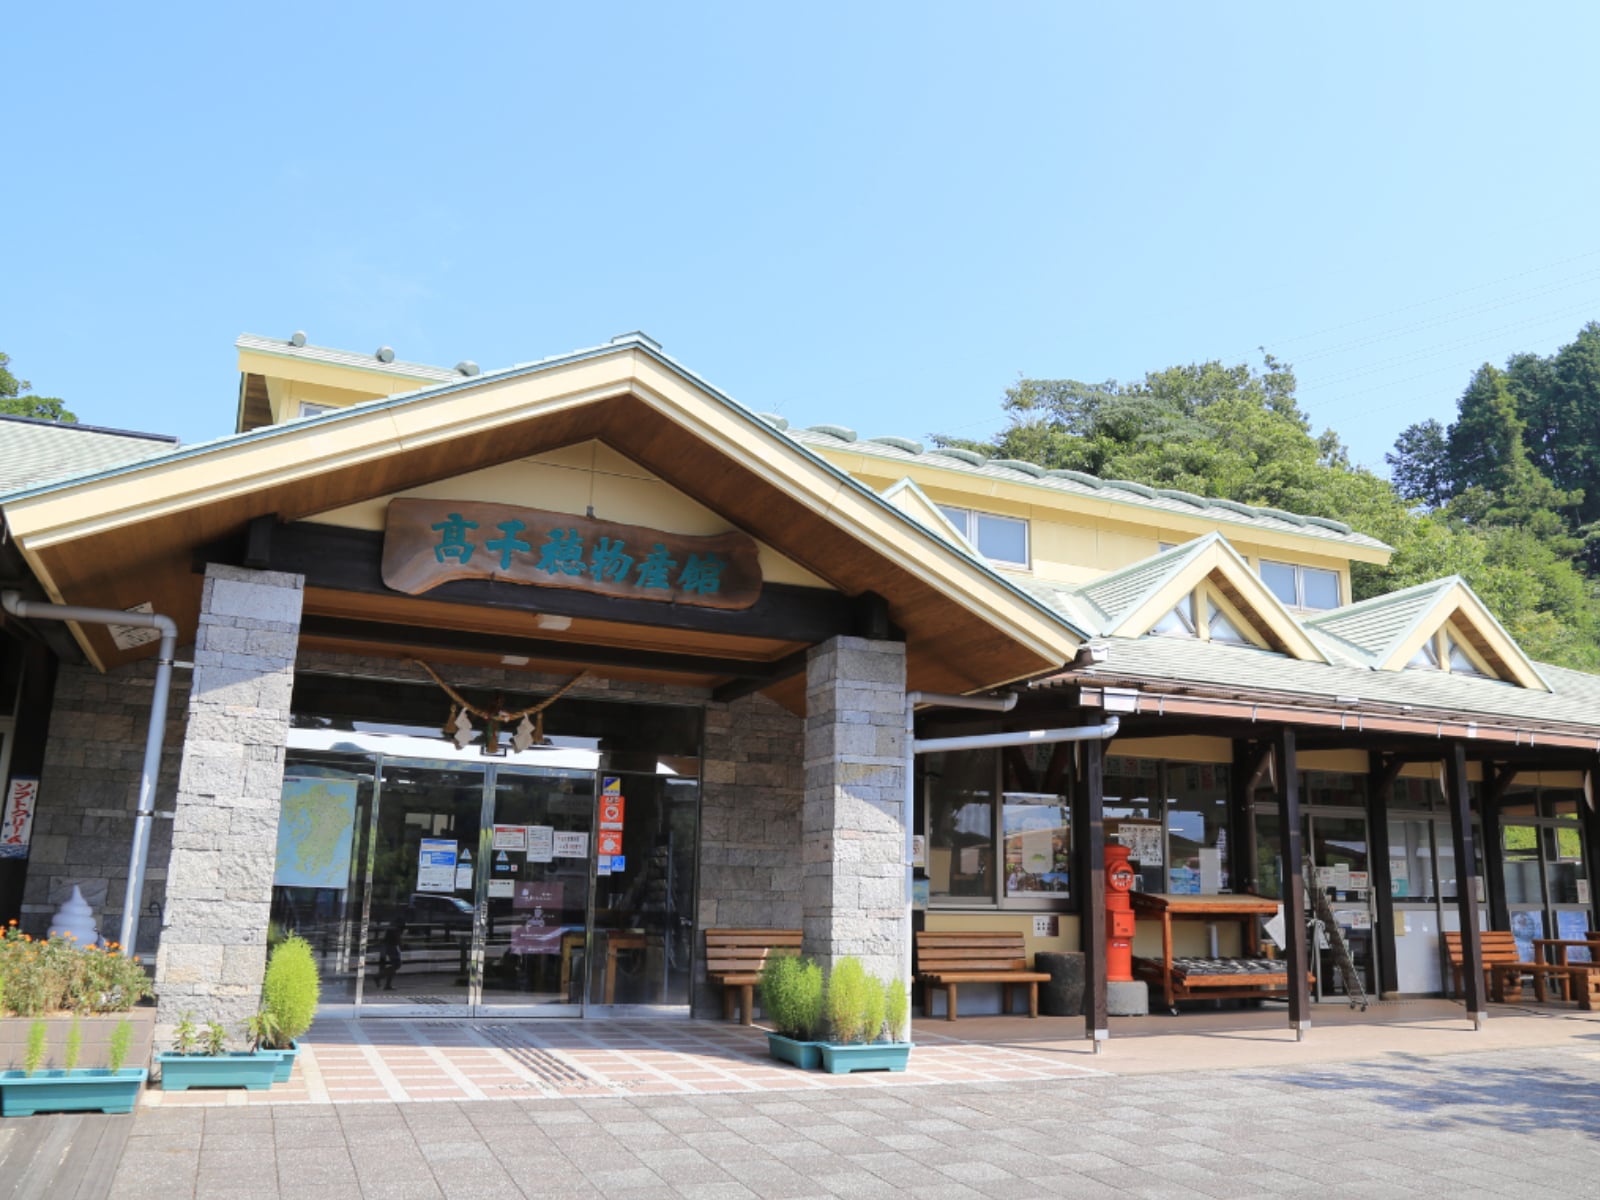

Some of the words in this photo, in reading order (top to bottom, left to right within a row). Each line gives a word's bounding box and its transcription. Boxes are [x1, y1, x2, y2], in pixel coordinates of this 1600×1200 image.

[6, 783, 32, 844] ソフトクリーム
